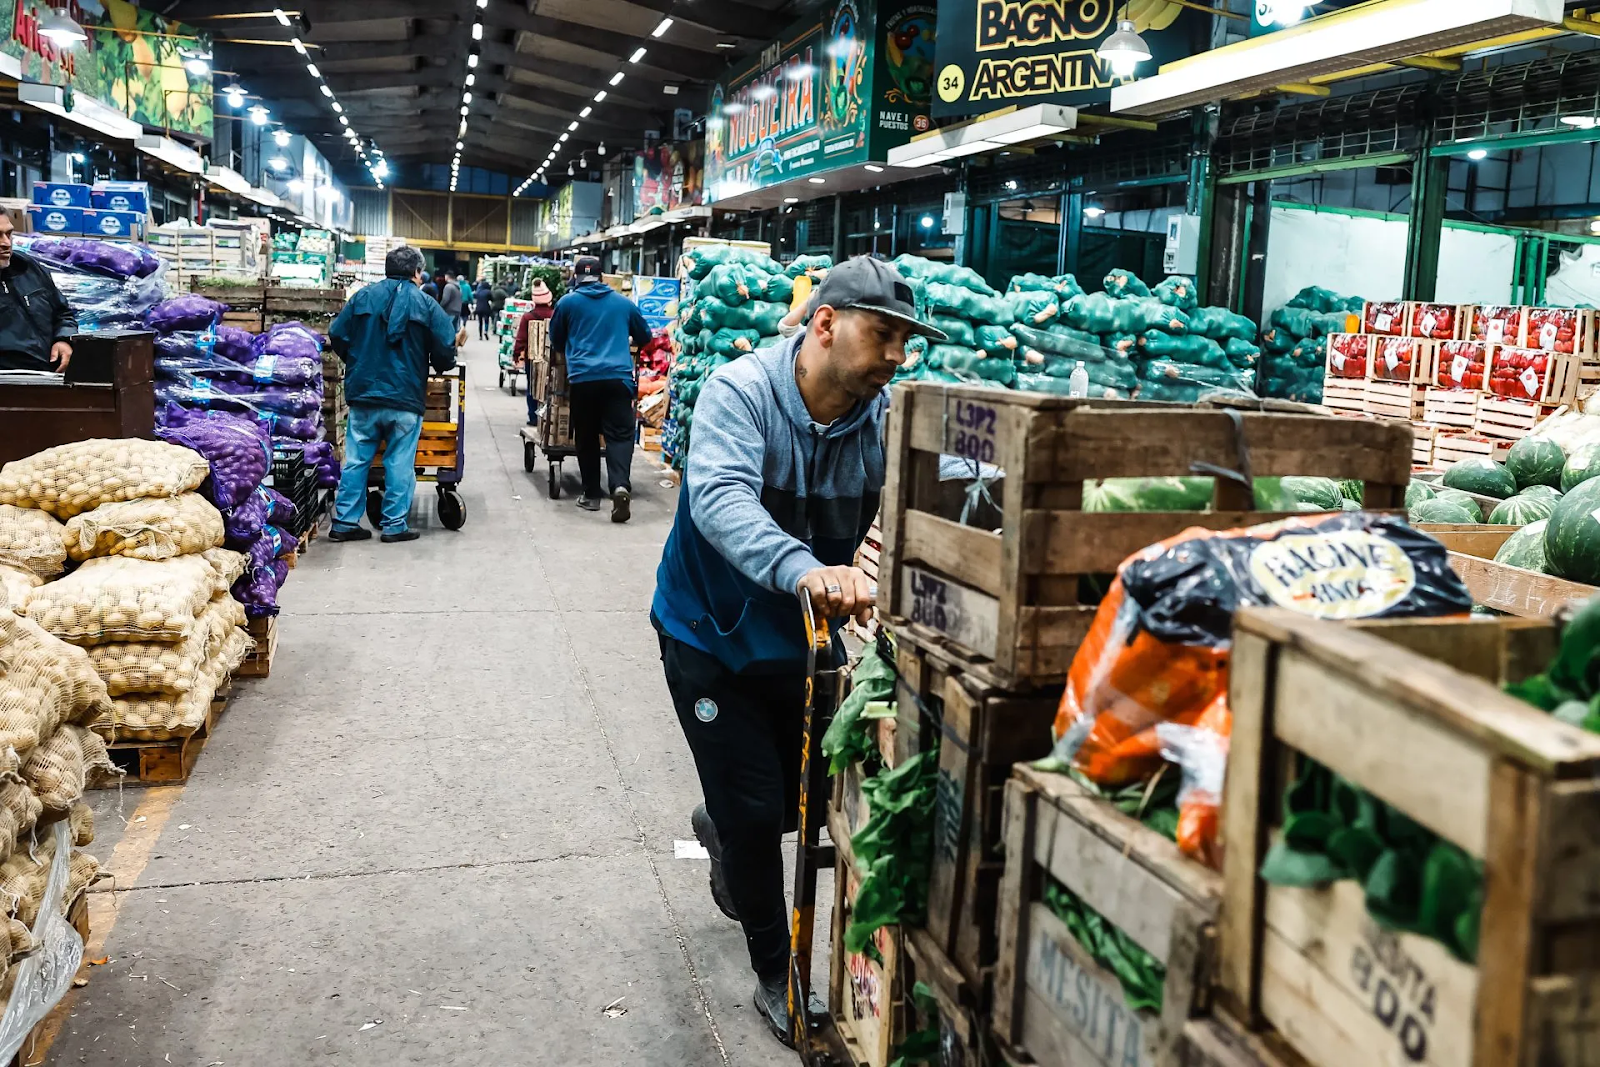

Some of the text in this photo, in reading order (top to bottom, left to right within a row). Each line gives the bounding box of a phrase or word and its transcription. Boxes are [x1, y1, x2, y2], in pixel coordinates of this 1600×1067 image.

[976, 0, 1114, 52] BAGNO
[943, 76, 958, 90] 34
[879, 110, 902, 122] NAVE
[878, 119, 909, 130] PUESTOS
